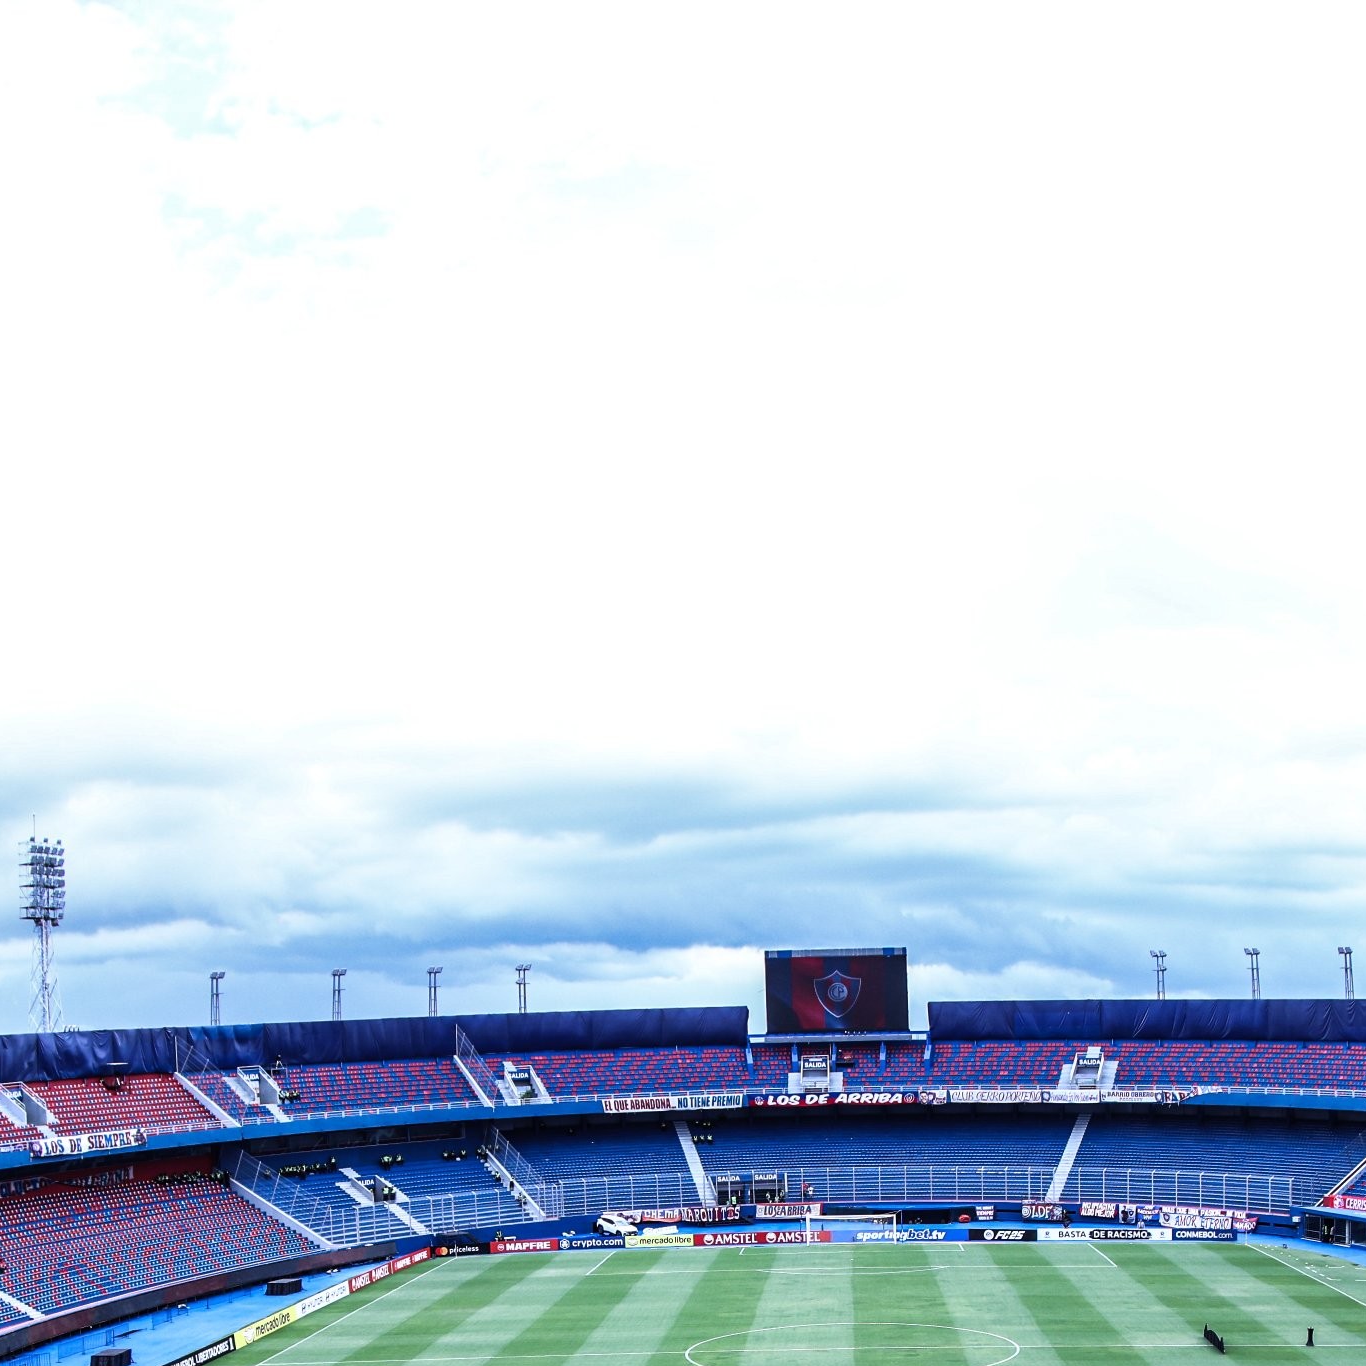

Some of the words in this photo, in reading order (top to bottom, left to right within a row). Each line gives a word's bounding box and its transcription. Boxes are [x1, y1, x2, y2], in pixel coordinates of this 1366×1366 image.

[767, 1094, 800, 1106] LOS
[805, 1094, 829, 1104] DE
[834, 1093, 902, 1104] ARRIBA
[976, 1091, 1004, 1102] CERRO
[604, 1100, 612, 1111] EL
[614, 1100, 630, 1111] QUE
[677, 1097, 688, 1108] NO
[689, 1096, 710, 1108] TIENE
[712, 1095, 740, 1107] PREMIO
[44, 1139, 64, 1155] LOS
[70, 1137, 82, 1152] DE
[88, 1131, 132, 1150] SIEMPRE
[681, 1207, 740, 1222] MARQUITOS
[779, 1206, 812, 1216] ARRIBA
[1095, 1209, 1115, 1218] MEJOR
[1175, 1215, 1197, 1228] AMOR
[639, 1236, 675, 1245] mercado
[675, 1236, 692, 1244] libre
[715, 1233, 758, 1245] AMSTEL
[777, 1231, 821, 1243] AMSTEL
[856, 1228, 946, 1242] sportingbet.tv
[1058, 1230, 1086, 1238] BASTA
[1093, 1230, 1106, 1238] DE
[1107, 1230, 1148, 1239] RACISMO
[506, 1241, 551, 1251] MAPFRE
[572, 1237, 624, 1248] crypto.com
[449, 1244, 479, 1254] priceless
[354, 1272, 371, 1290] AMSTEL
[375, 1264, 390, 1281] AMSTEL
[255, 1316, 280, 1337] mercado
[279, 1312, 290, 1331] libre
[195, 1339, 229, 1364] LIBERTADORES
